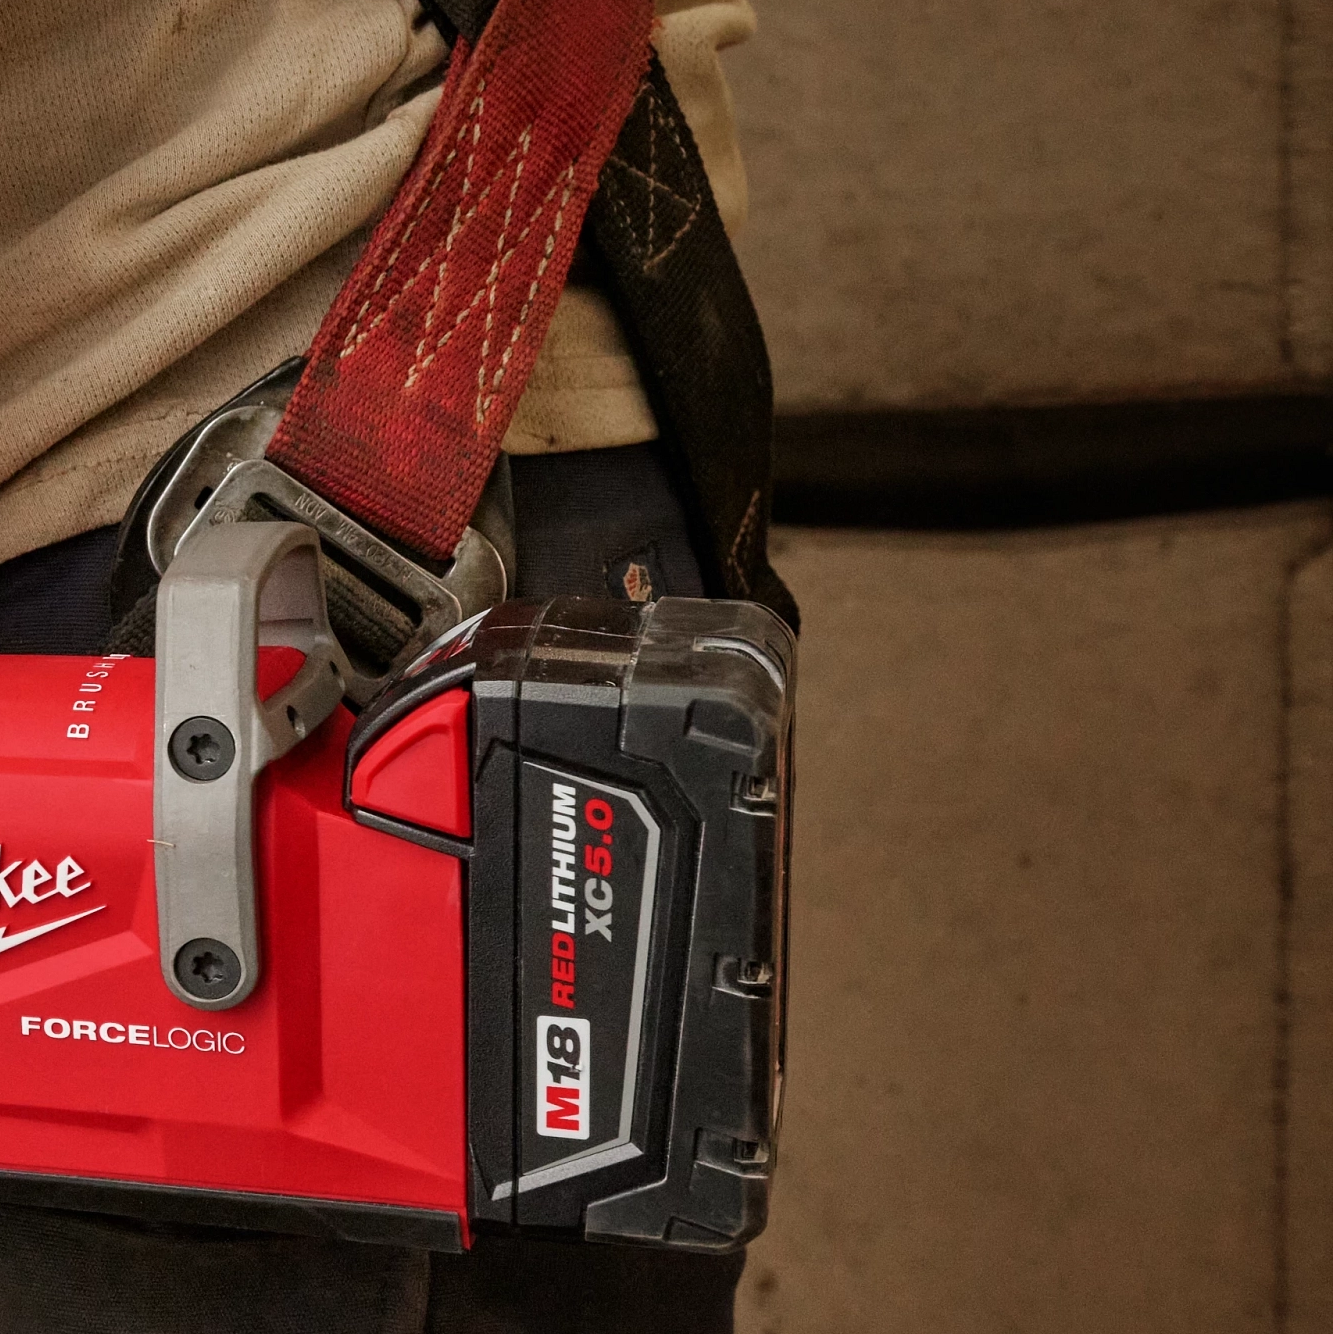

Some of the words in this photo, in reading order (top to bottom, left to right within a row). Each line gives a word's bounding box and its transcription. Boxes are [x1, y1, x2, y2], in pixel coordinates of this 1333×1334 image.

[551, 782, 577, 1010] REDLITHIUM
[584, 797, 614, 943] XC5.0
[20, 1015, 246, 1055] FORCELOGIC
[546, 1023, 582, 1132] M18
